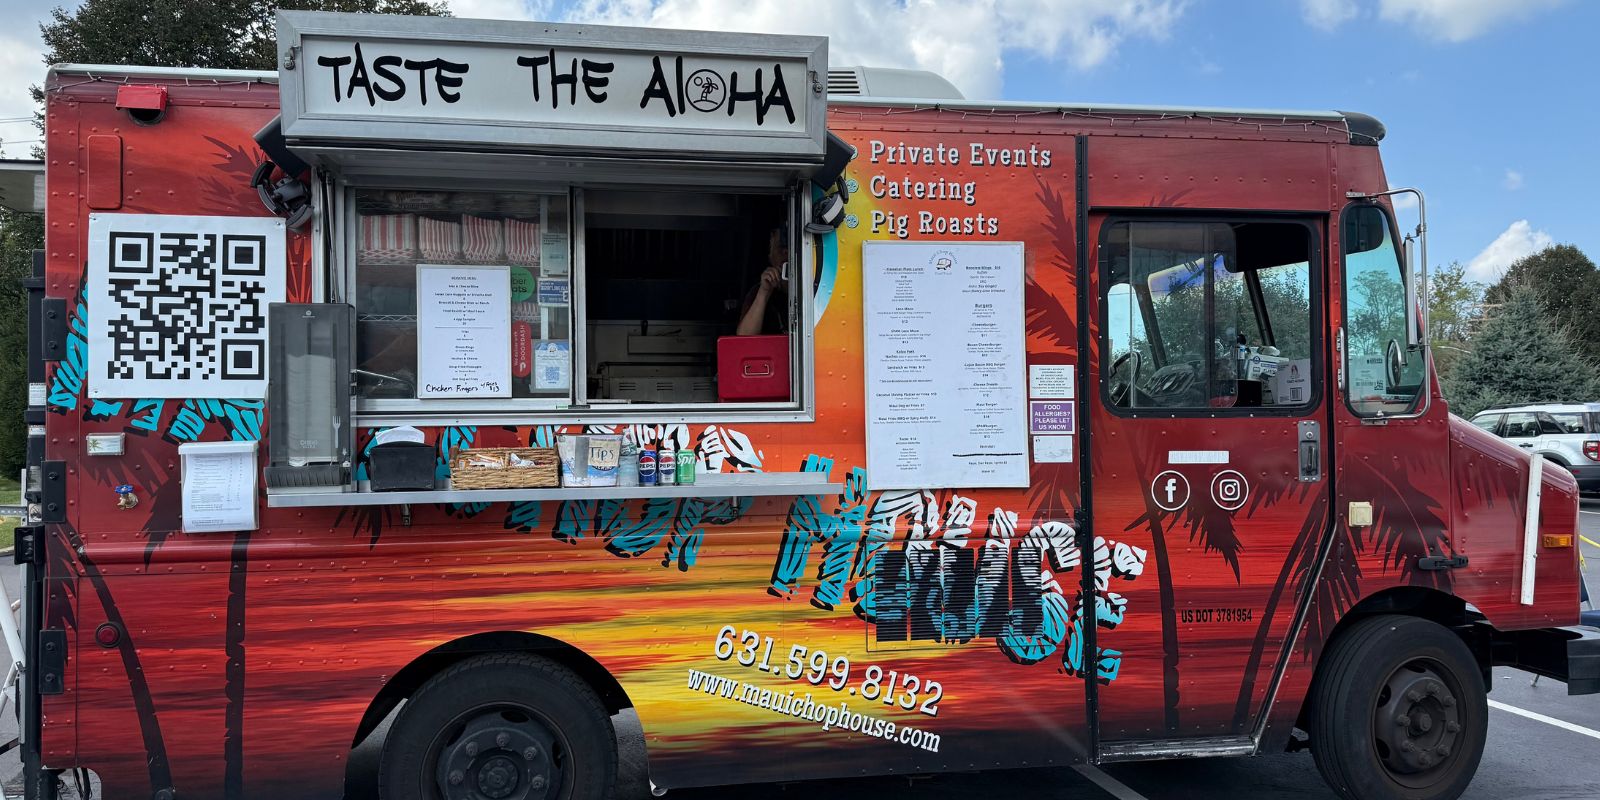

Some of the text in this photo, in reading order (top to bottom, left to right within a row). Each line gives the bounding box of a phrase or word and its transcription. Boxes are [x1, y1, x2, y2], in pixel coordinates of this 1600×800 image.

[317, 42, 469, 107] TASTE
[516, 48, 614, 109] THE
[870, 140, 1052, 167] Private Events
[870, 175, 976, 205] Catering
[870, 210, 999, 239] Pig Roasts
[589, 446, 614, 461] Tips
[677, 454, 695, 466] Spri
[1181, 608, 1252, 623] US DOT 3781954
[714, 624, 943, 716] 631.599.8132
[687, 668, 942, 753] www.mauichophouse.com
